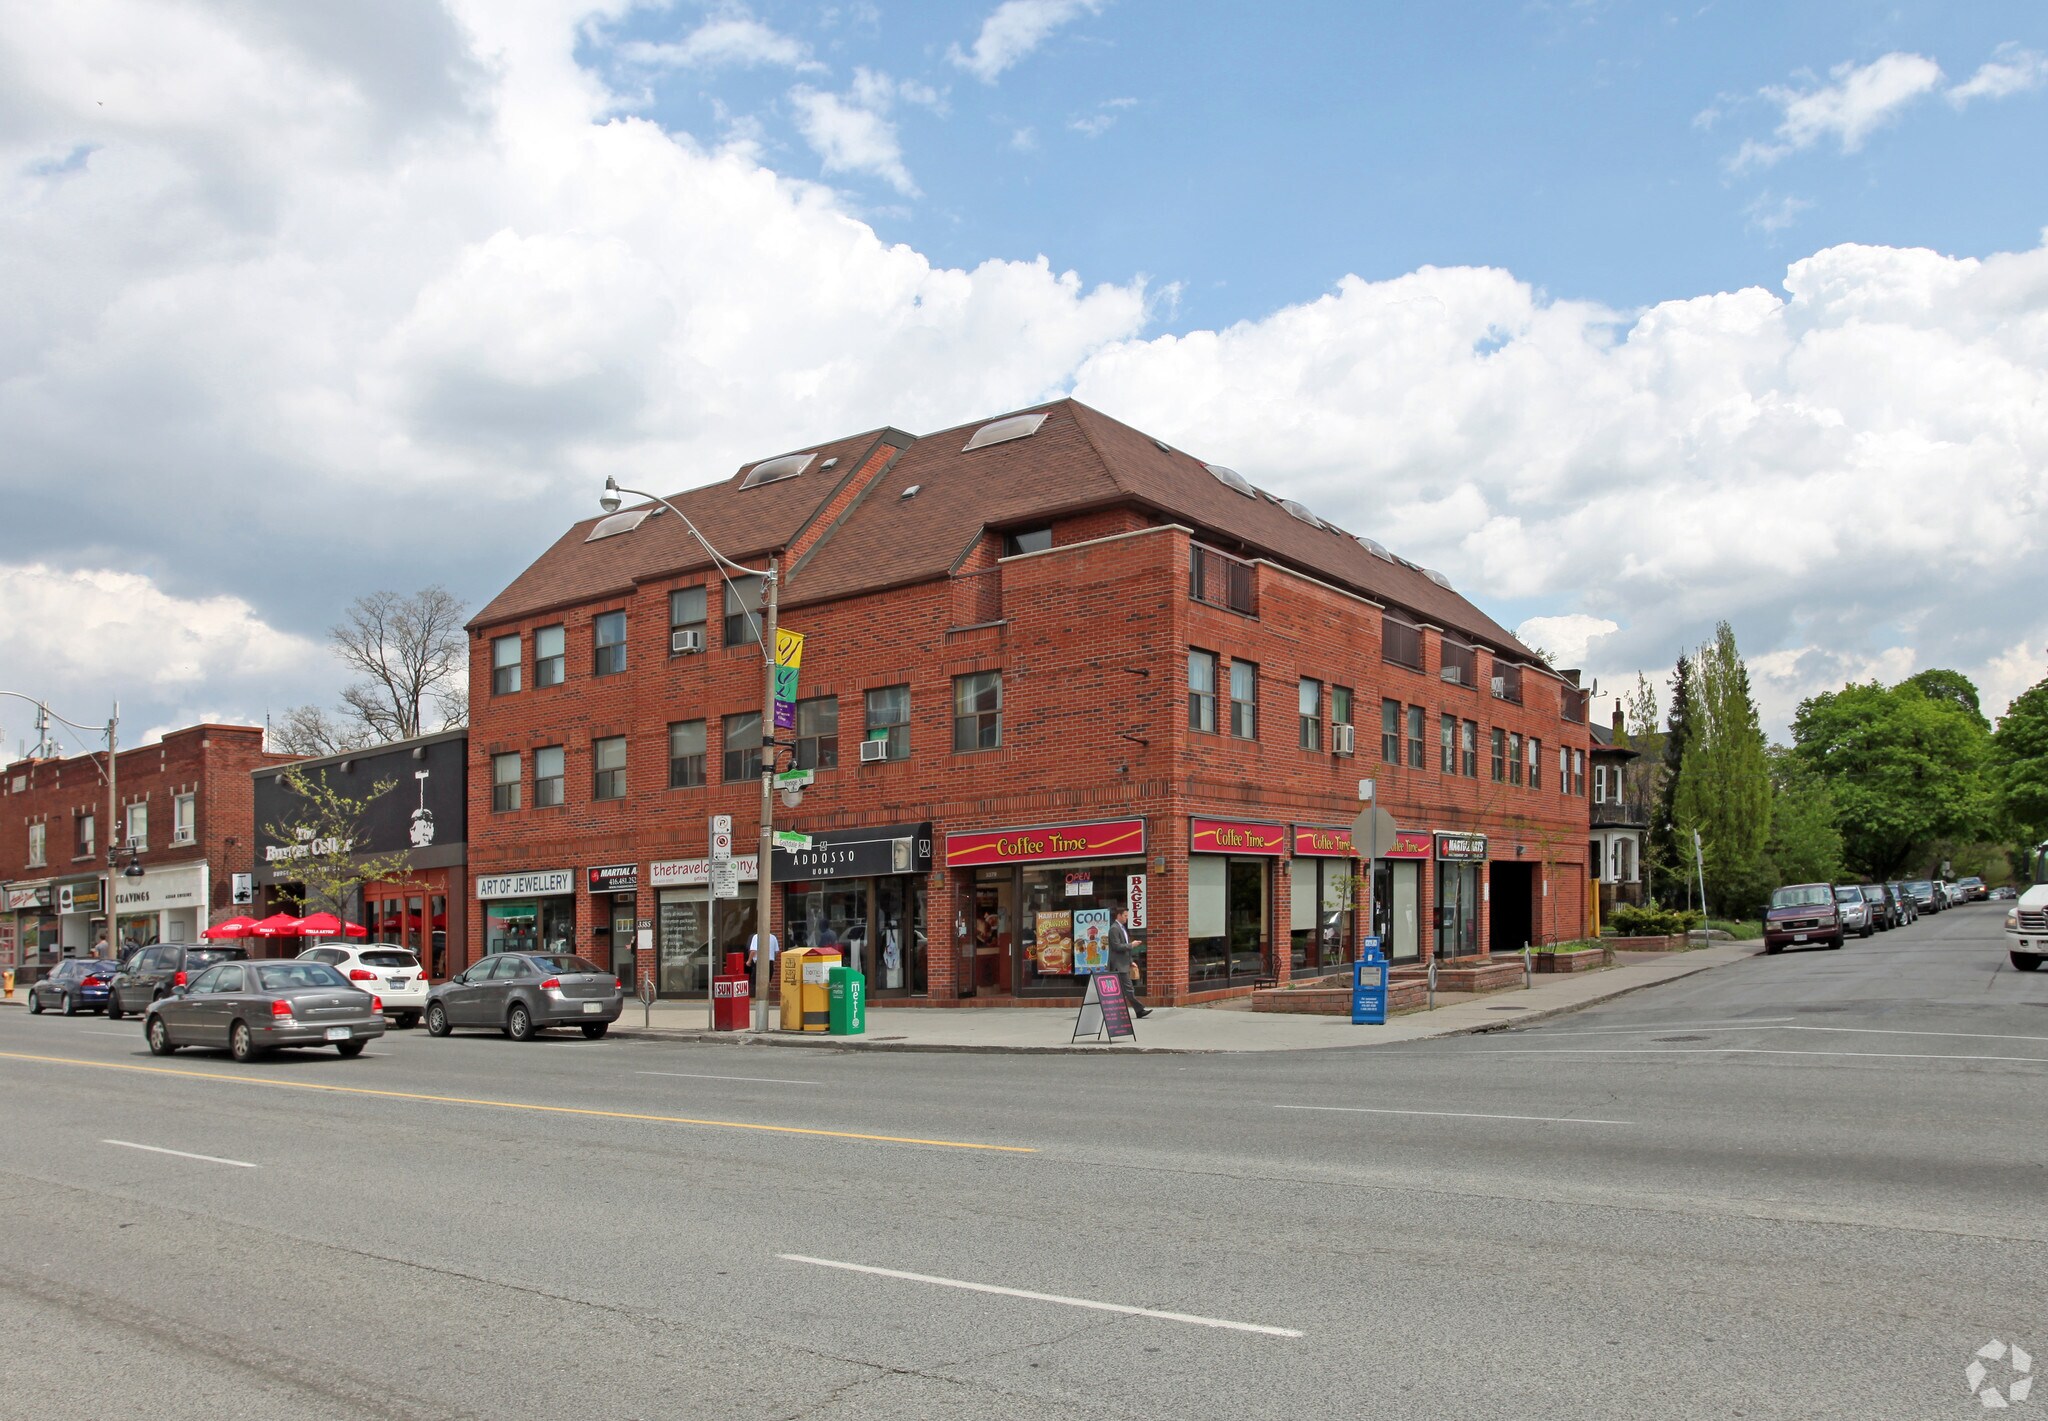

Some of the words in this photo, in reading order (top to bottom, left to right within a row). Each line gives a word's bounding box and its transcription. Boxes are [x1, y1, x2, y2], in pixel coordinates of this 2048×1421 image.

[997, 837, 1044, 856] Coffee
[1049, 832, 1087, 852] Time
[1216, 828, 1242, 847] Coffee
[1245, 830, 1264, 848] Time
[1312, 833, 1333, 850] Coffee
[1335, 835, 1350, 851] Time
[1405, 839, 1418, 853] Time
[793, 851, 855, 865] ADDOSSO
[600, 867, 630, 877] MARTIAL
[1065, 872, 1090, 884] OPEN
[481, 880, 498, 895] ART
[500, 879, 511, 894] OF
[514, 874, 568, 893] JEWELLERY
[116, 891, 150, 904] CRAVINGS
[1130, 877, 1143, 927] BAGELS
[1076, 912, 1108, 924] COOL
[718, 983, 731, 994] SUN
[736, 982, 748, 993] SUN
